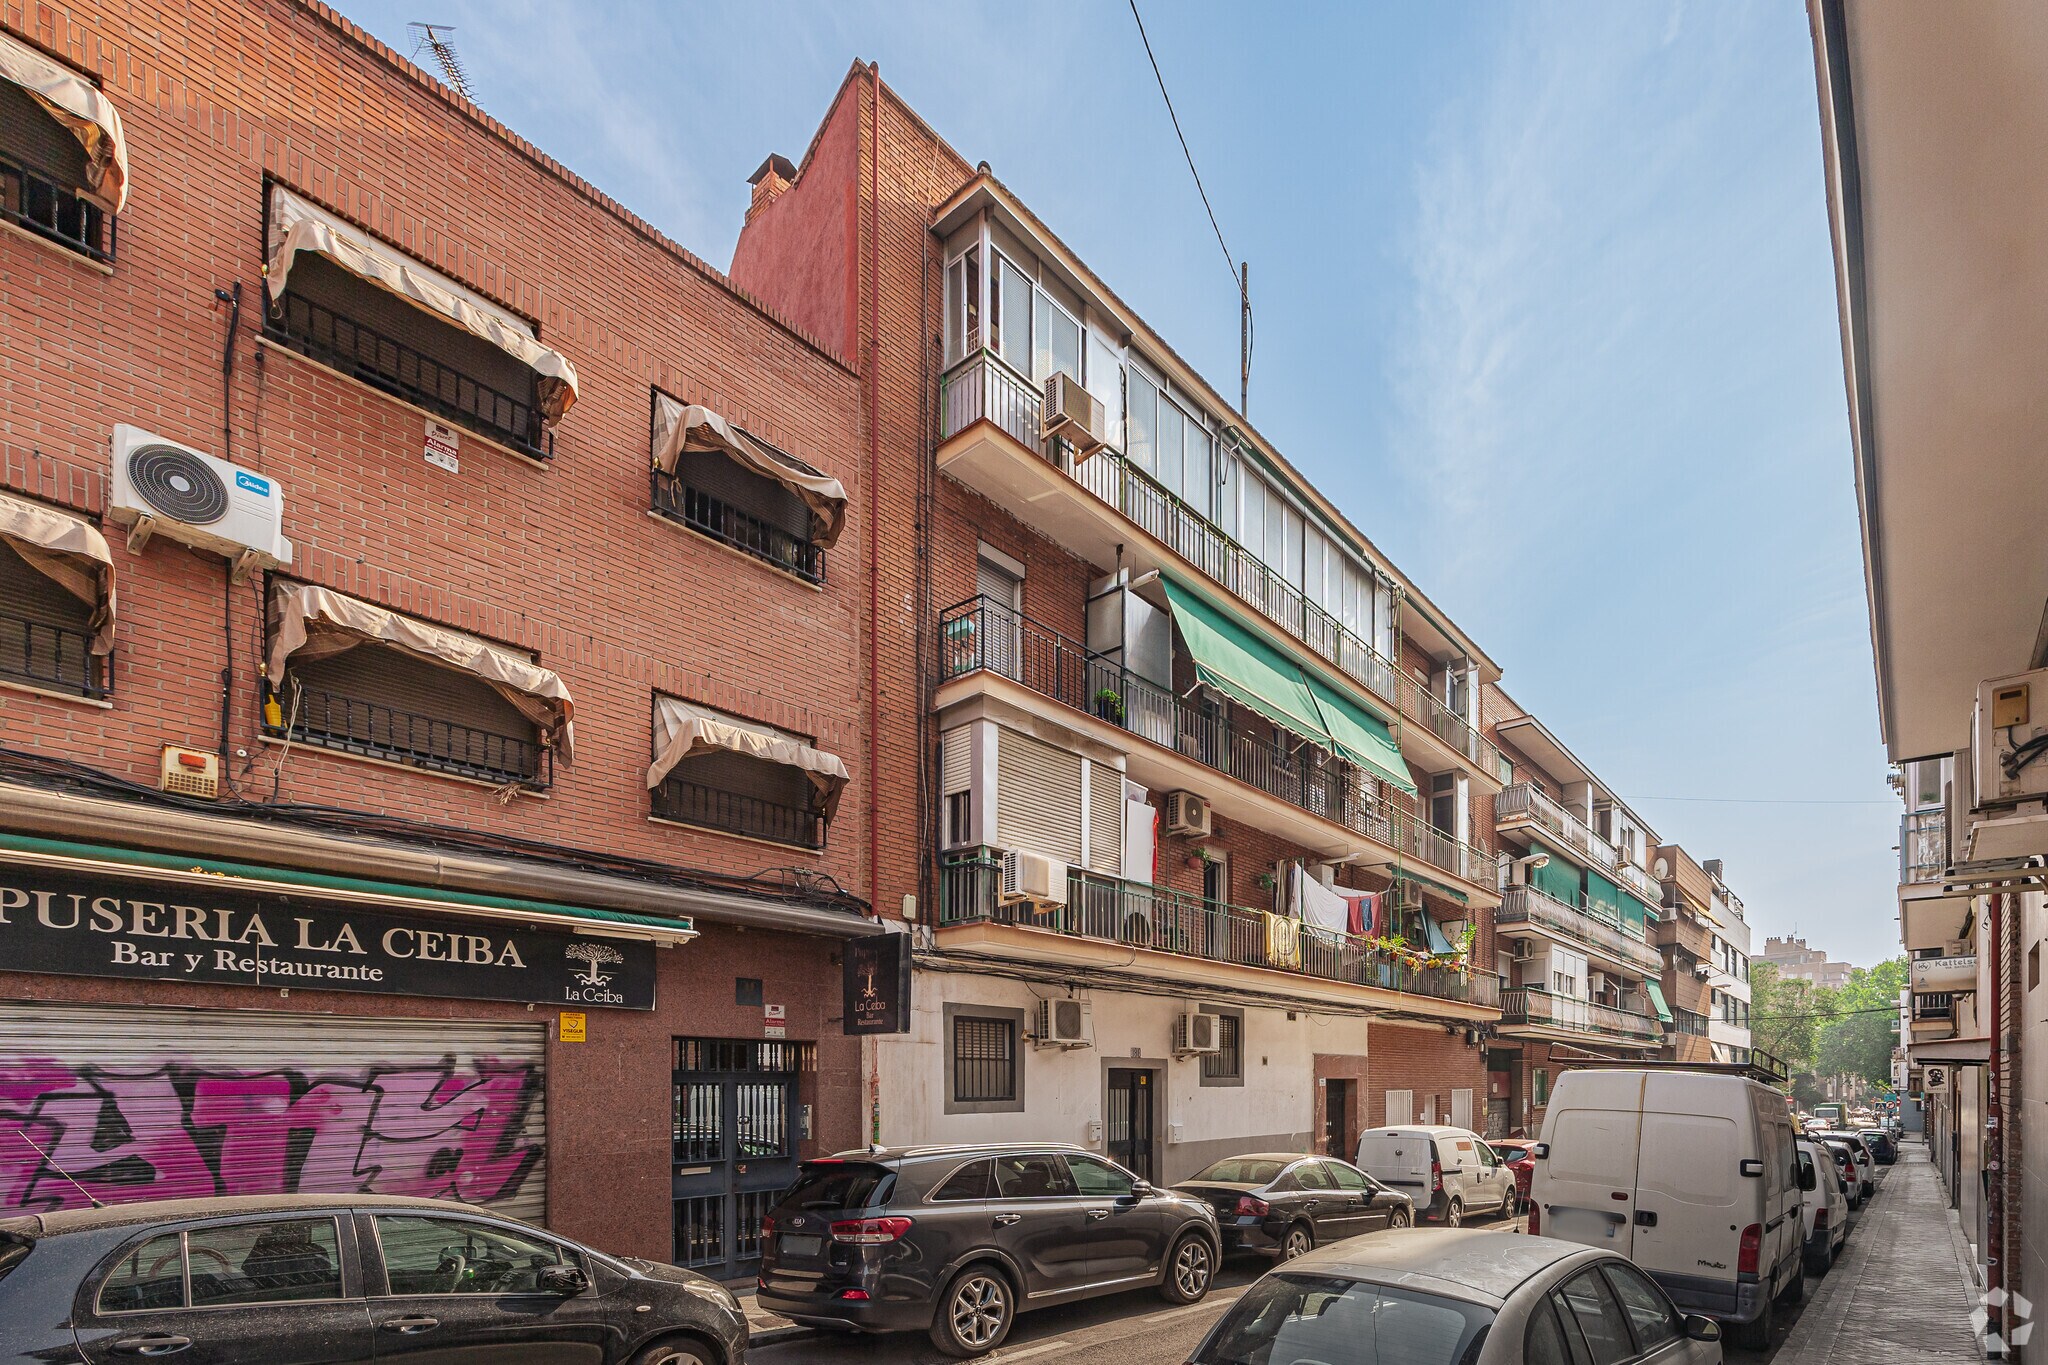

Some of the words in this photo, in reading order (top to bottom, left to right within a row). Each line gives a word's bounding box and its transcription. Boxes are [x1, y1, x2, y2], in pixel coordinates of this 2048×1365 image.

[426, 438, 457, 456] Alarma
[238, 475, 268, 493] Midea
[0, 887, 272, 948] PUSERIA
[293, 917, 369, 955] LA
[382, 926, 527, 968] CEIBA
[111, 941, 175, 968] Bar
[185, 953, 202, 974] y
[214, 948, 384, 983] Restaurante
[565, 986, 580, 1001] La
[582, 987, 624, 1004] Ceiba
[854, 1000, 865, 1012] La
[865, 997, 886, 1011] Ceiba
